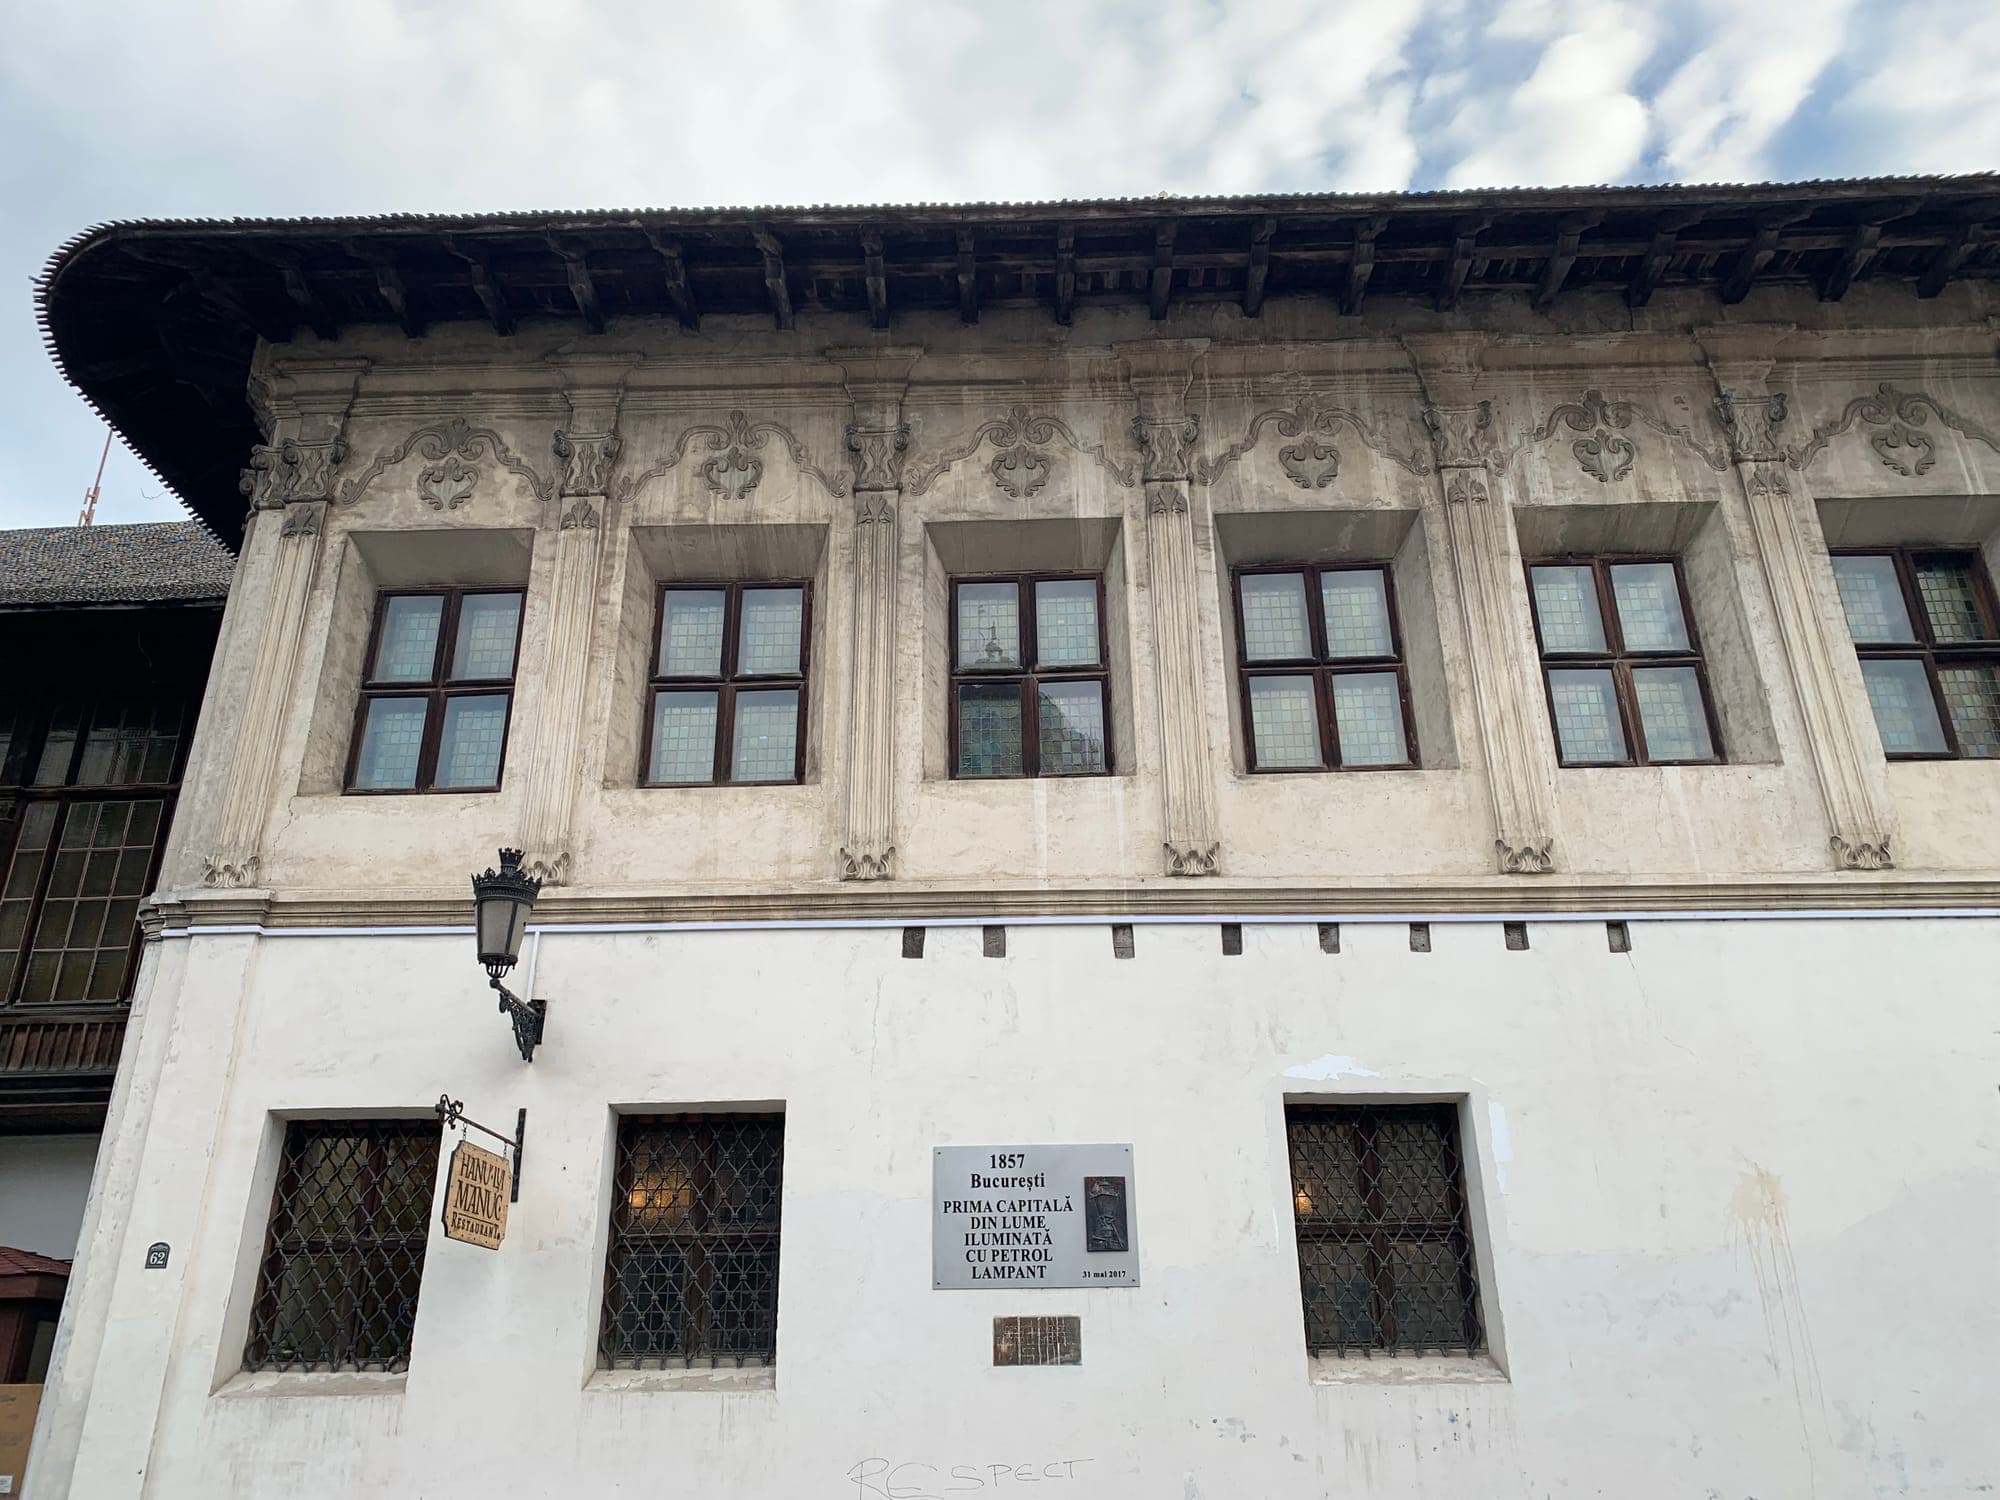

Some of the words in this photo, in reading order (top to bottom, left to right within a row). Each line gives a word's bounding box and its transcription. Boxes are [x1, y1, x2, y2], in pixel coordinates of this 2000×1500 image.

[990, 1154, 1025, 1169] 1857
[971, 1173, 1045, 1190] București
[454, 1179, 503, 1221] MANUC
[943, 1200, 993, 1213] PRIMA
[996, 1196, 1073, 1212] CAPITALĂ
[971, 1216, 997, 1229] DIN
[1001, 1215, 1046, 1229] LUME
[965, 1229, 1053, 1246] ILUMINATĂ
[150, 1252, 165, 1264] 62
[966, 1249, 986, 1262] CU
[991, 1248, 1053, 1262] PETROL
[972, 1265, 1047, 1279] LAMPANT
[1082, 1270, 1091, 1278] 31
[1093, 1270, 1107, 1278] mai
[1108, 1270, 1126, 1278] 2017
[846, 1457, 1095, 1500] RESPECT
